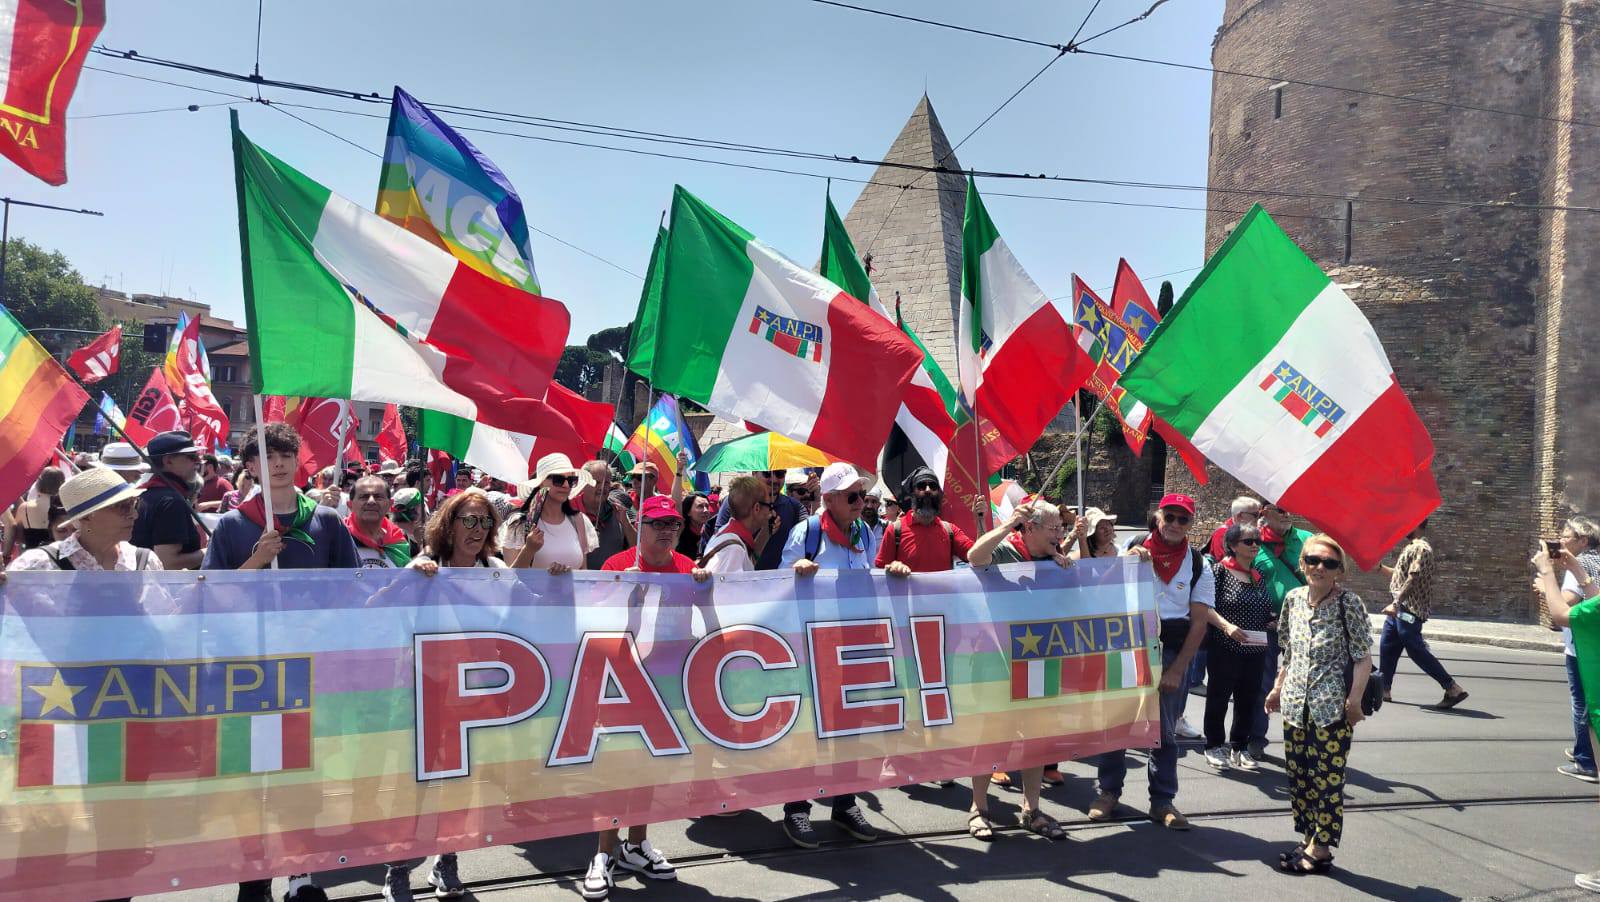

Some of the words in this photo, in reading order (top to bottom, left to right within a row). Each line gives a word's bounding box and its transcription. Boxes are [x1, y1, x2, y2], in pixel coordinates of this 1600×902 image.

[1287, 375, 1339, 422] A.N.P.I.
[1045, 615, 1143, 656] A.N.P.I.
[89, 661, 304, 718] A.N.P.I.
[413, 614, 954, 782] PACE!
